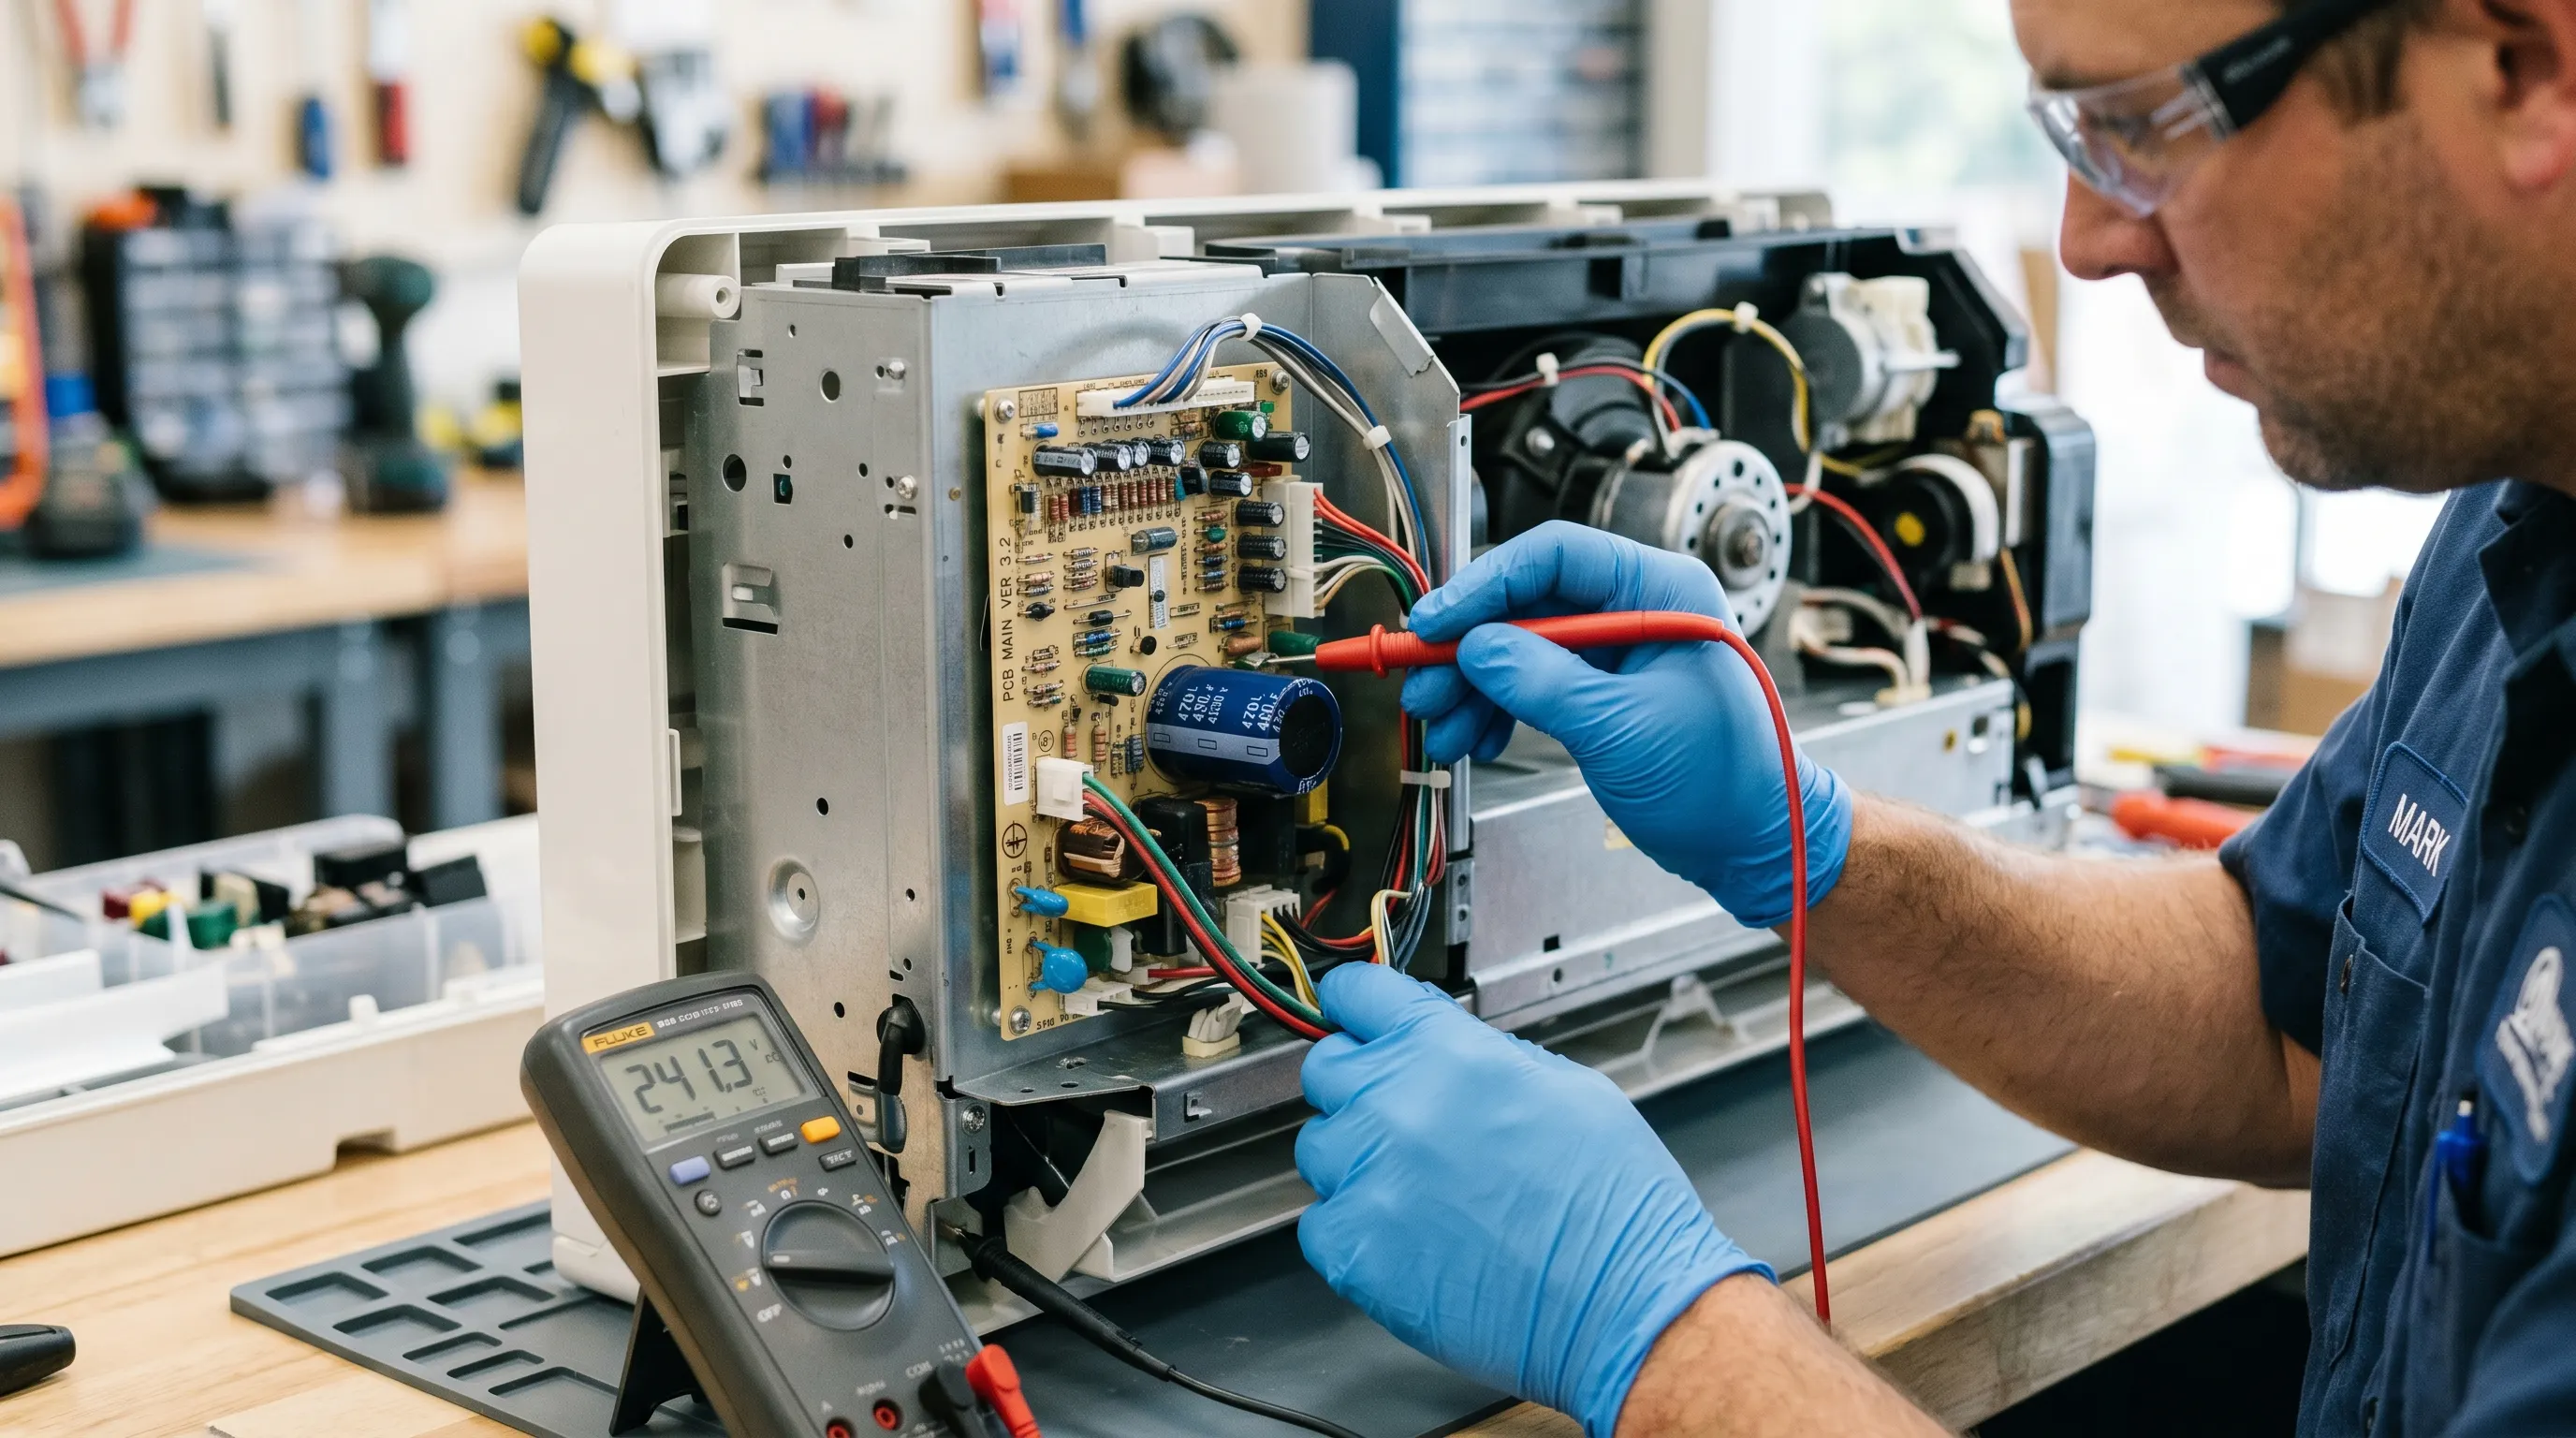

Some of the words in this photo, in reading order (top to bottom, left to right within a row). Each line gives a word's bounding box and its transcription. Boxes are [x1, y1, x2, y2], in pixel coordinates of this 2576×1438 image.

[1000, 536, 1012, 566] 3.2
[1001, 577, 1013, 609] VER
[1002, 619, 1014, 660] MAIN
[1003, 668, 1015, 701] PCB
[2388, 793, 2451, 877] MARK
[593, 1026, 649, 1049] FLUKE
